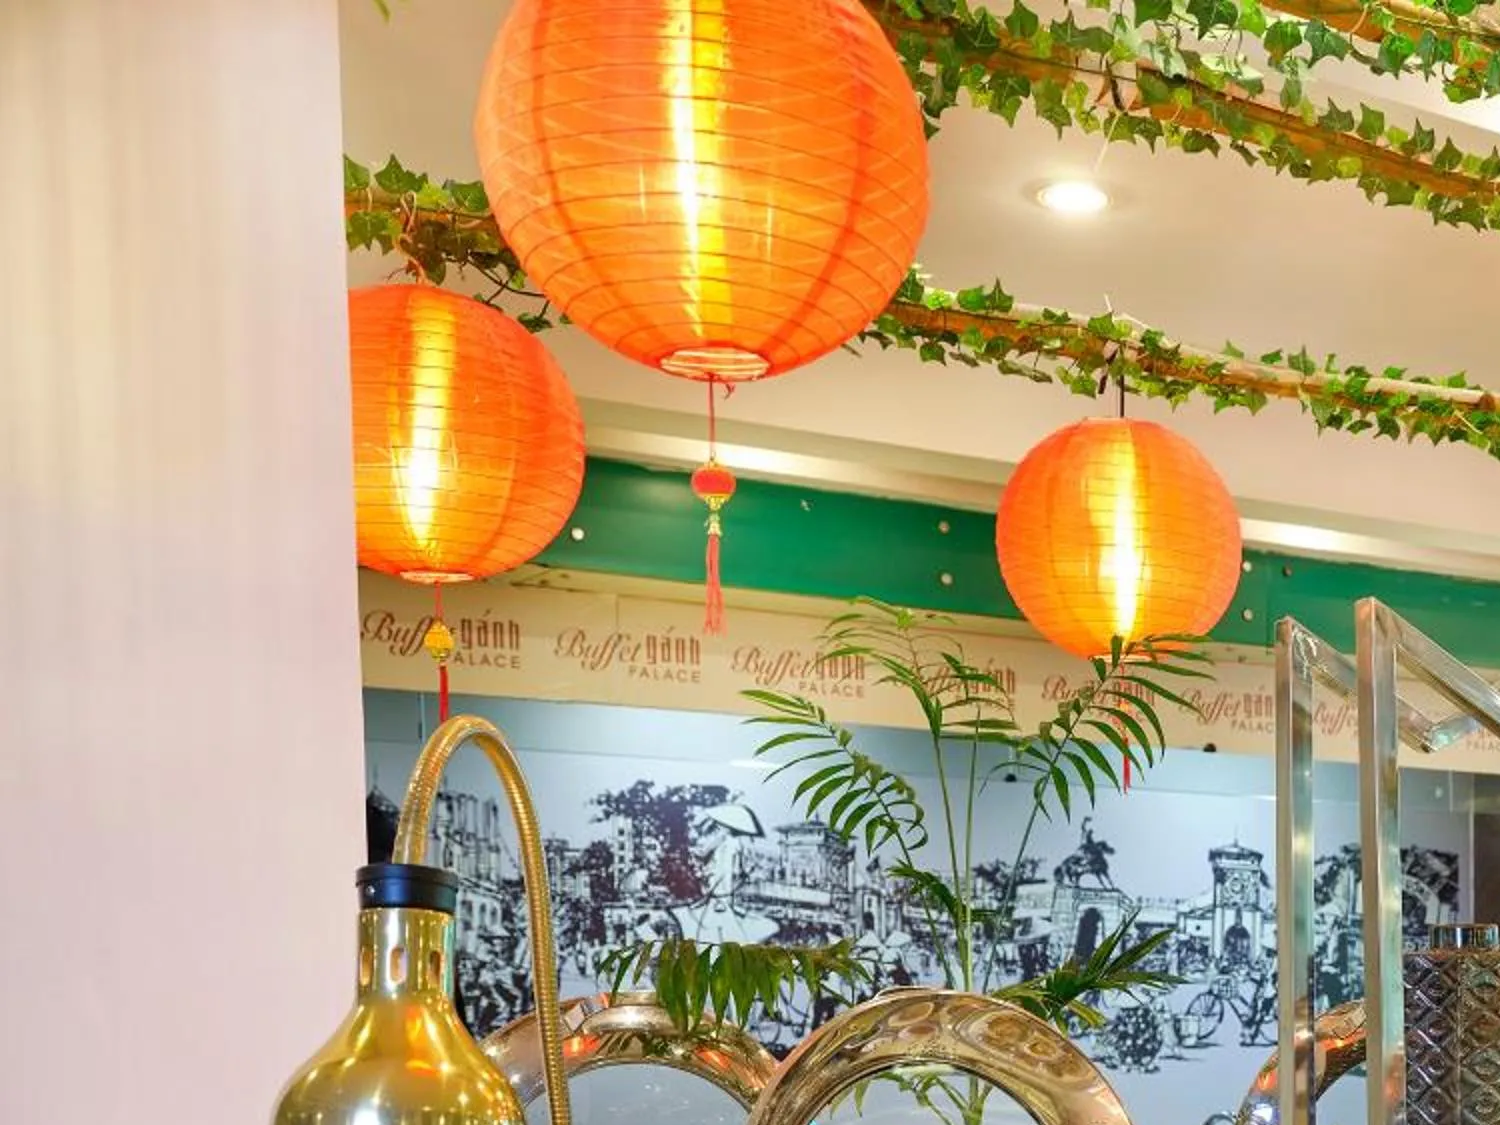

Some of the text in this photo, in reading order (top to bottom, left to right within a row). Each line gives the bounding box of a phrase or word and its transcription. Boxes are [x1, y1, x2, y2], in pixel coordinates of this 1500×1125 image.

[361, 608, 520, 657] Buff gánh
[554, 625, 700, 671] Buffet gánh
[628, 665, 701, 683] PALACE
[731, 646, 813, 686] Buffet
[799, 681, 866, 698] PALACE
[1243, 684, 1274, 718] gán
[1231, 719, 1274, 735] PALAC
